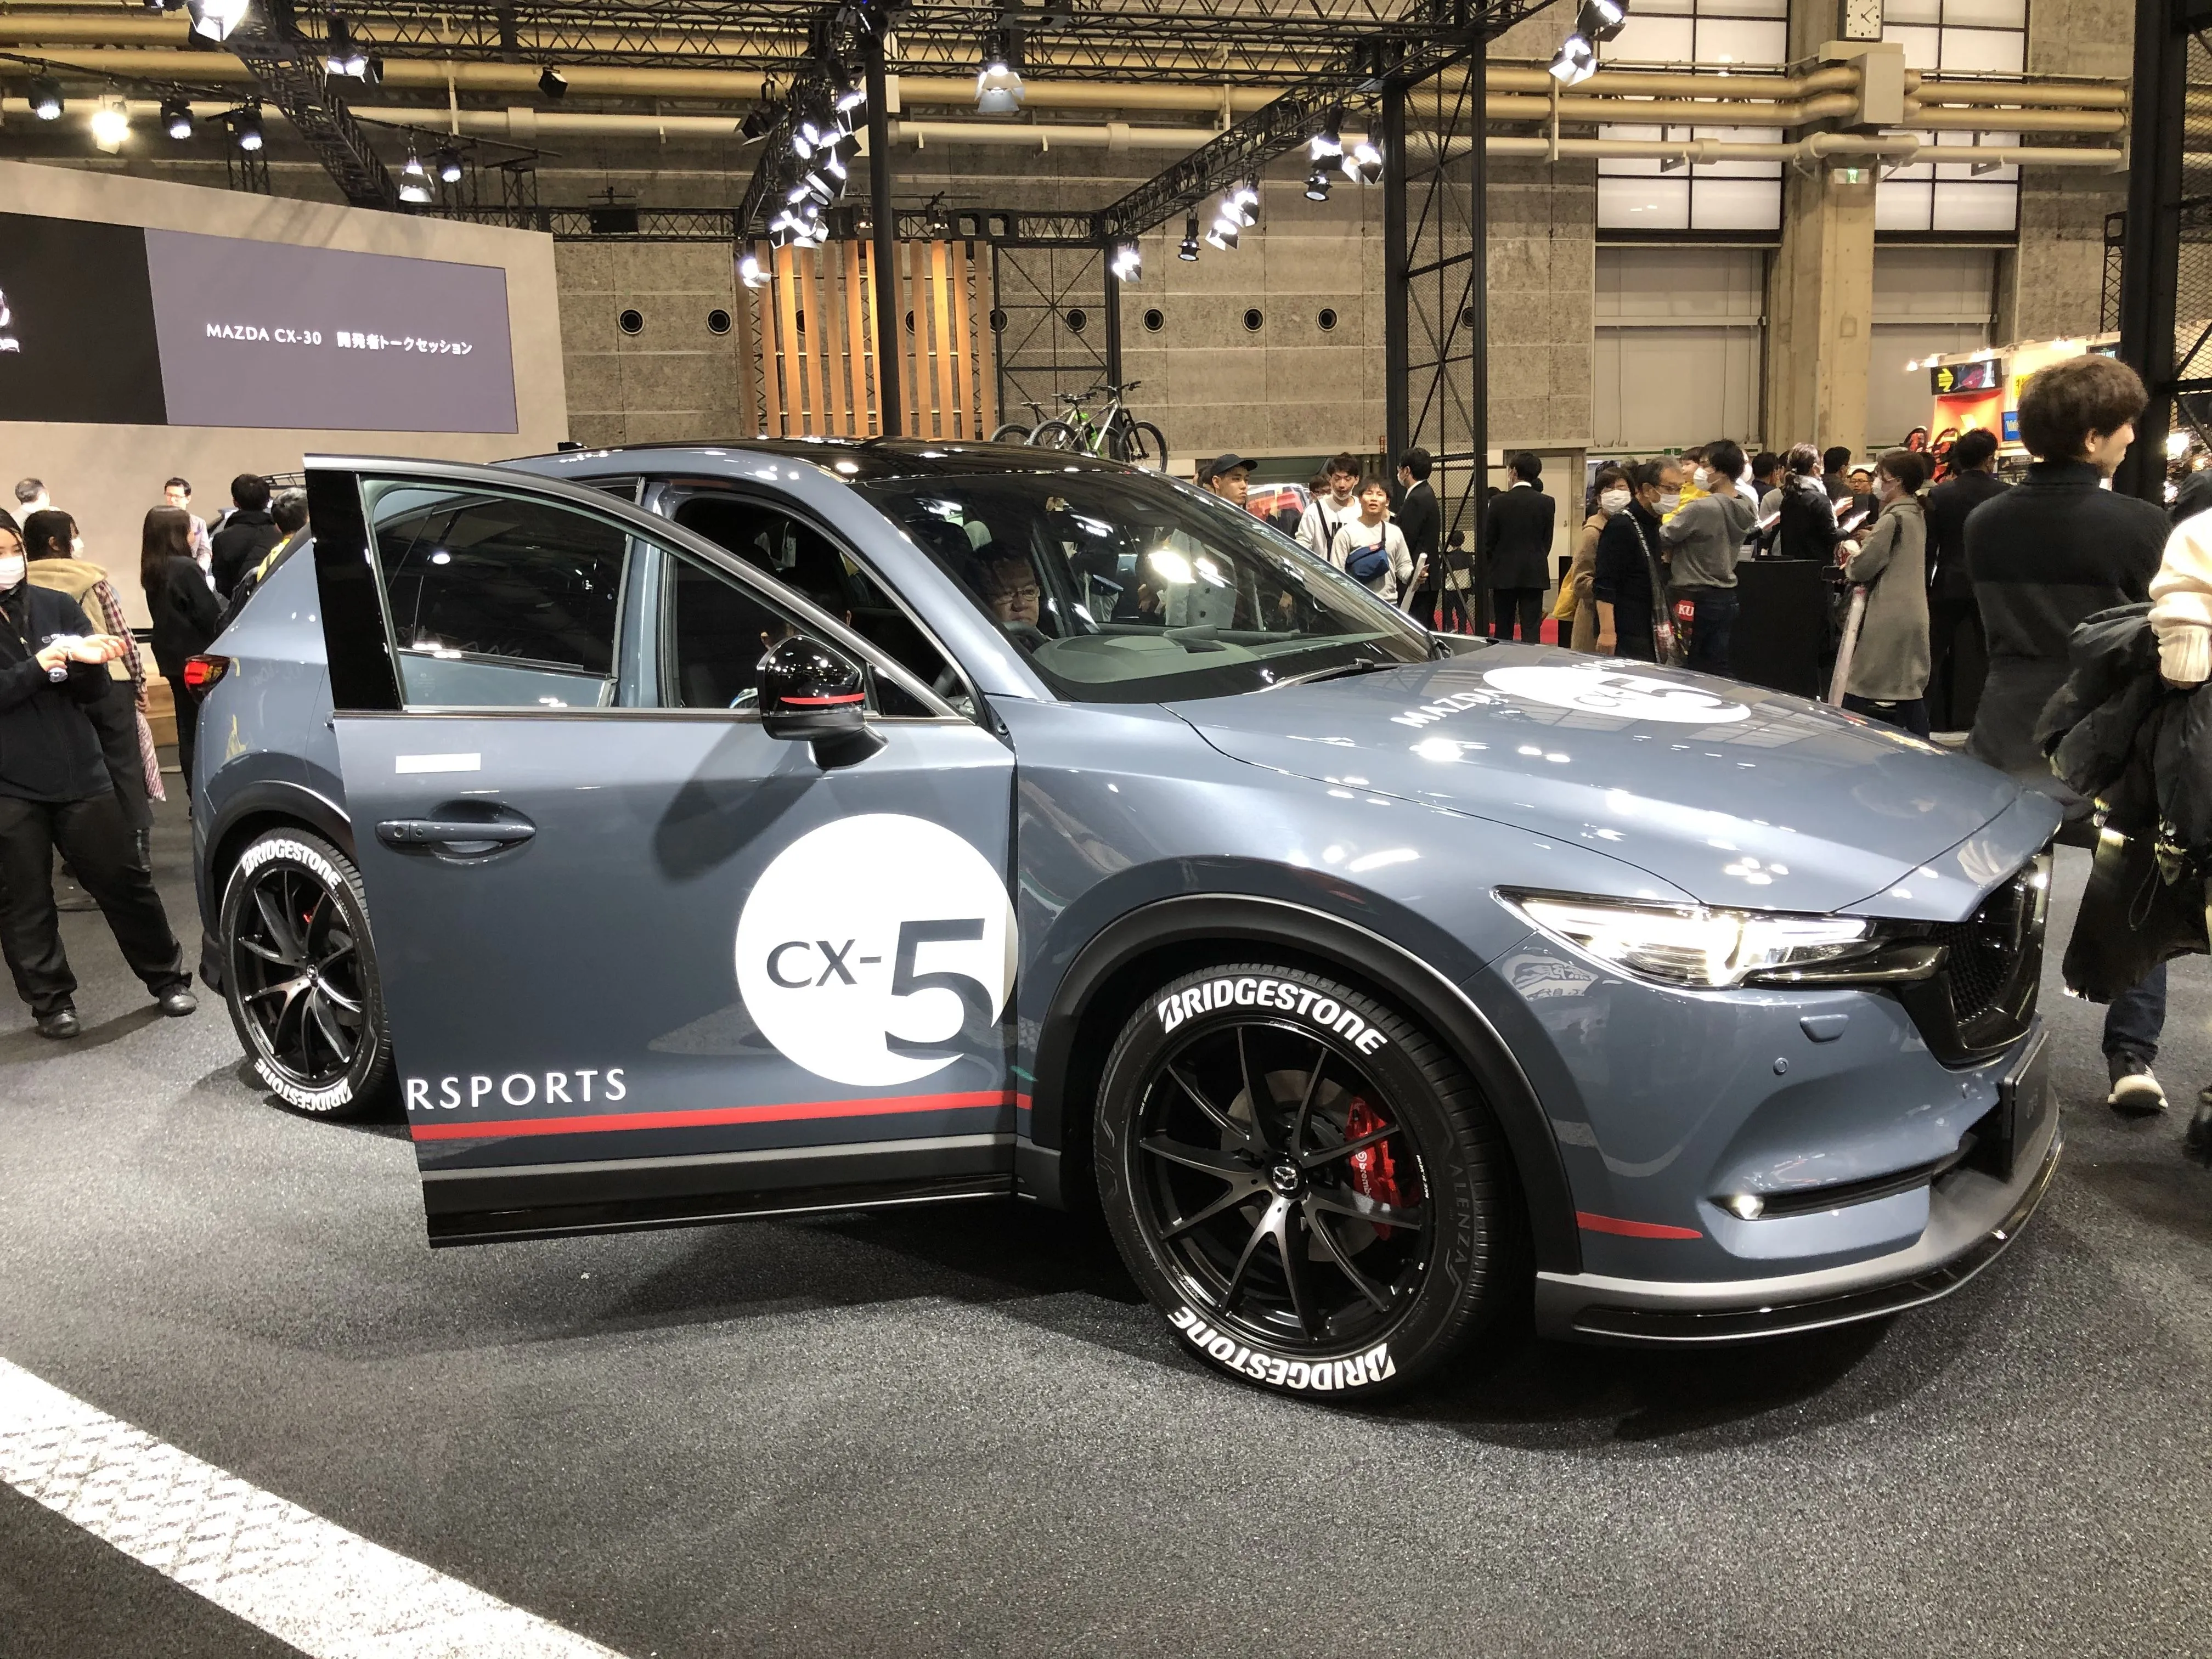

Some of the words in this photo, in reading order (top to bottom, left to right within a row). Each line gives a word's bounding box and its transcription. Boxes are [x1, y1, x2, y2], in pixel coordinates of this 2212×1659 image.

[207, 323, 270, 341] MAZDA
[274, 329, 322, 345] CX-30
[336, 331, 472, 355] 開発者トークセッション
[1390, 688, 1512, 729] MAZDA
[1573, 678, 1741, 710] CX-5
[241, 839, 342, 890] BRIDGESTONE
[766, 918, 994, 1060] CX-5
[1158, 978, 1387, 1056] BRIDGESTONE
[254, 1058, 353, 1111] BRIDGESTONE
[407, 1068, 627, 1110] RSPORTS
[1449, 1164, 1470, 1263] ALENZA
[1167, 1306, 1397, 1391] BRIDGESTONE
